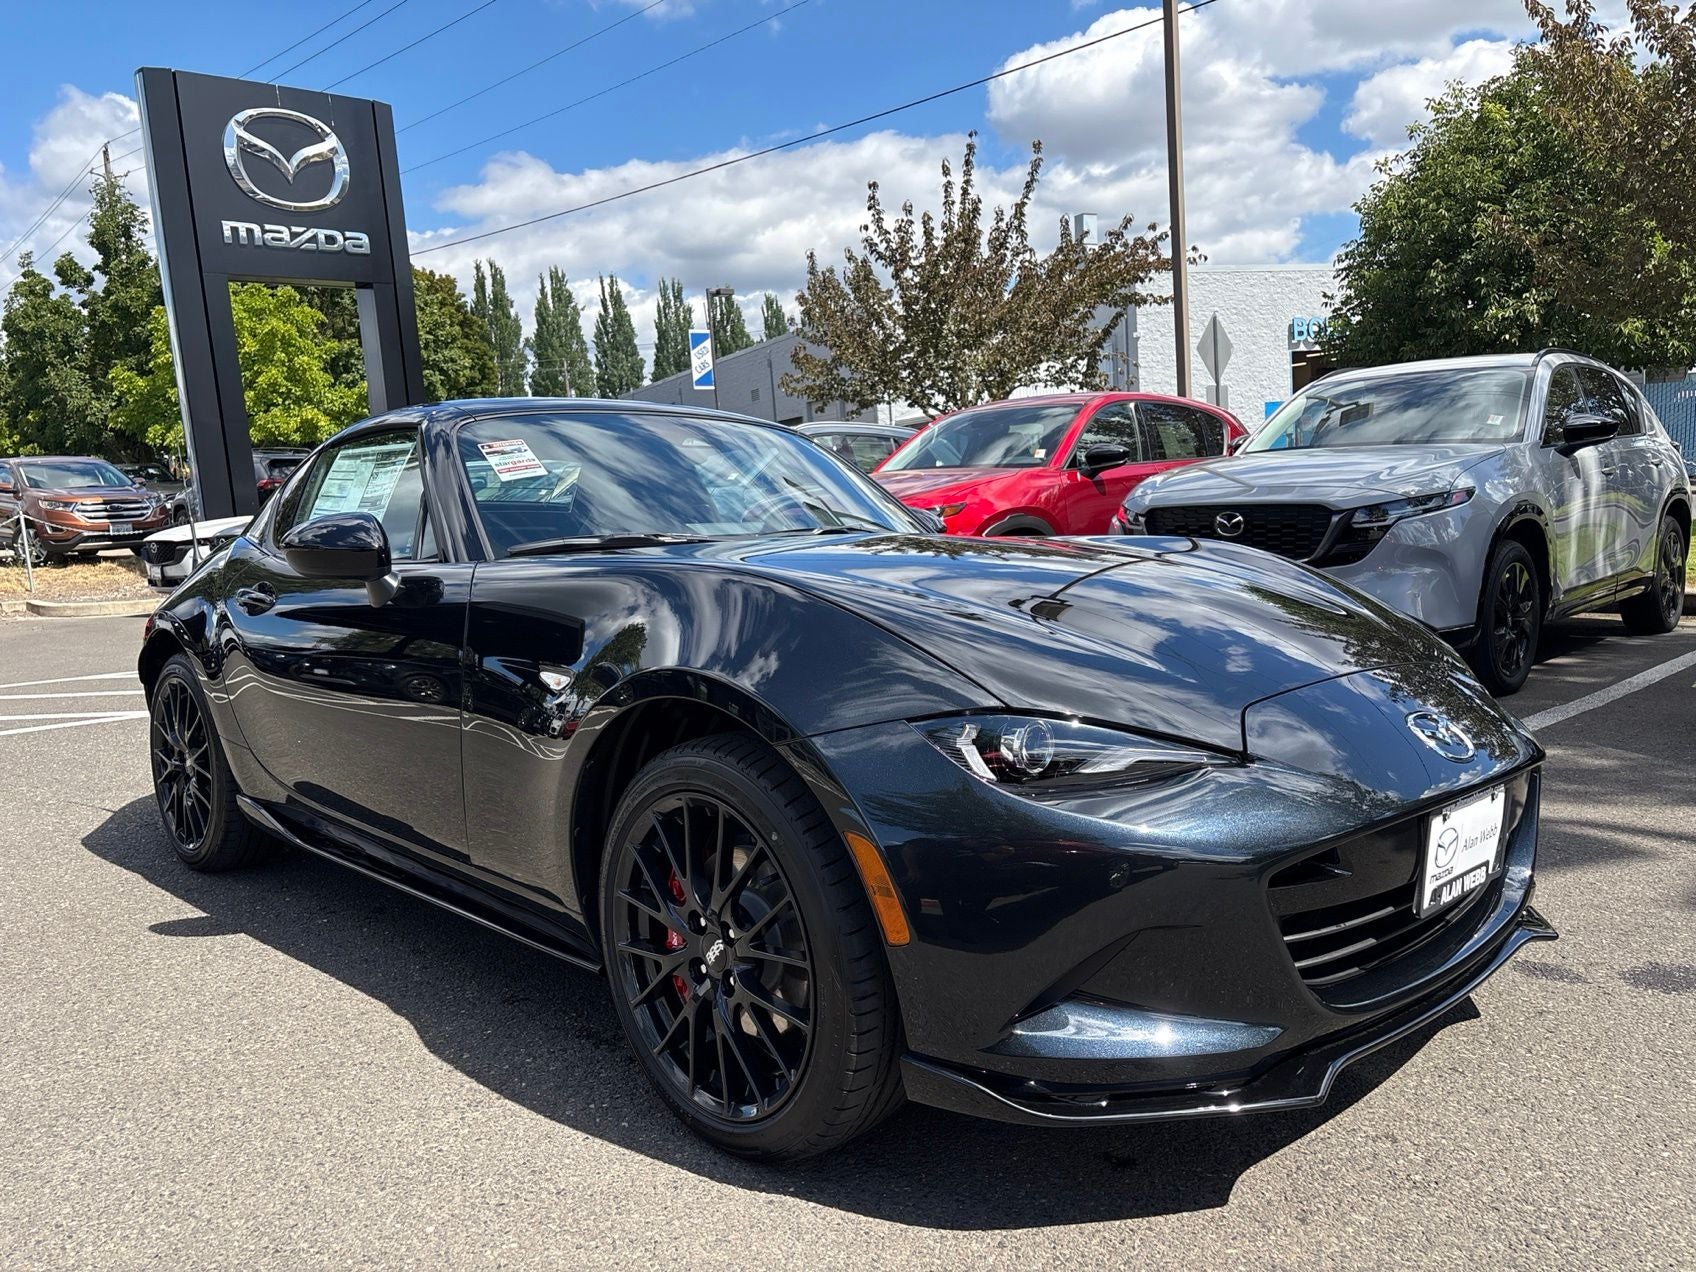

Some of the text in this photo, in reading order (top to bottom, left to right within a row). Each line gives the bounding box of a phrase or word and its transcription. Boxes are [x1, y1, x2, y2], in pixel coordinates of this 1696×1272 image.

[1461, 823, 1498, 853] Alan Webb
[1440, 866, 1487, 905] ALAN WEBB
[705, 939, 724, 965] BBS
